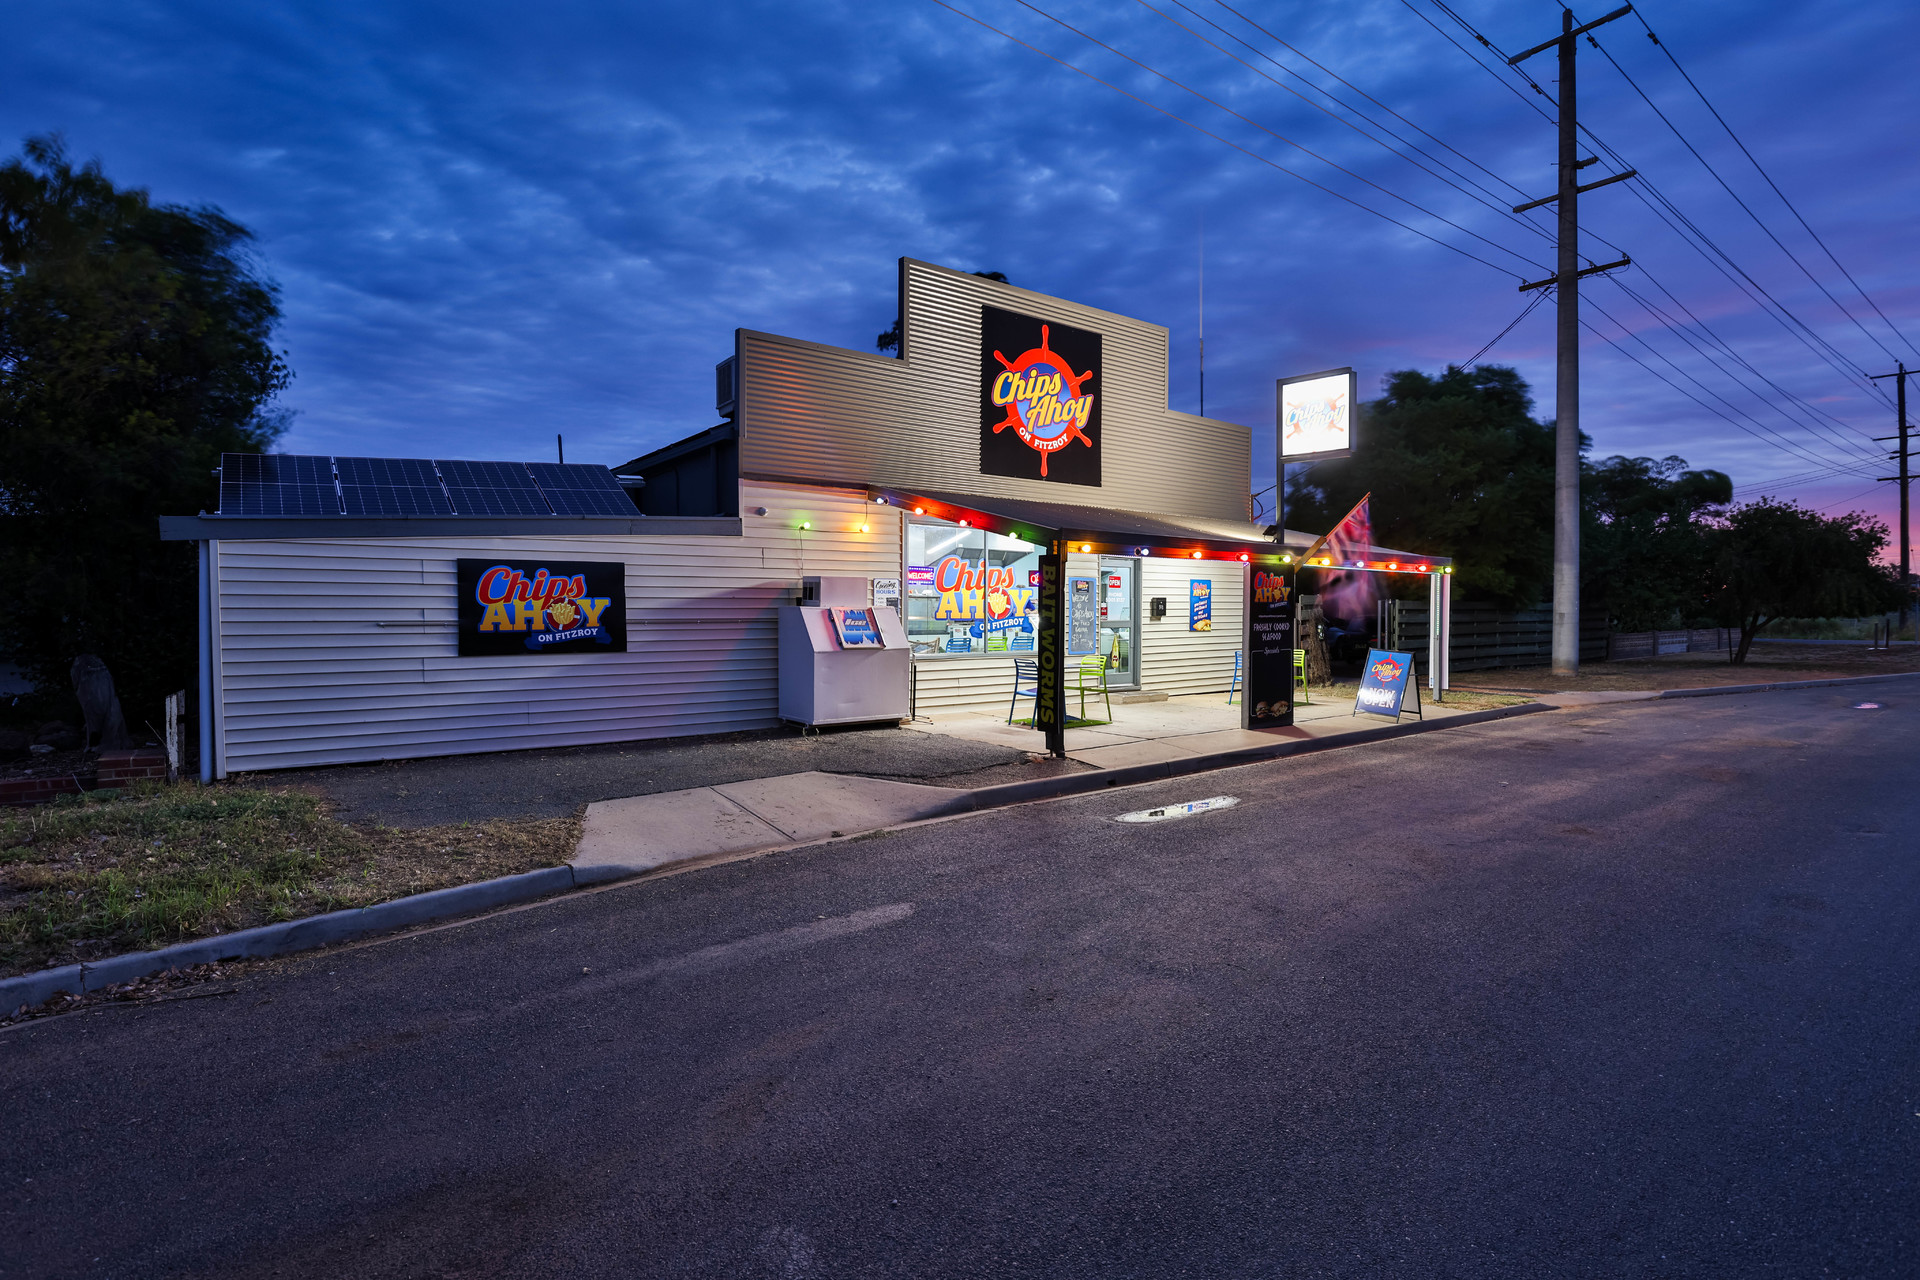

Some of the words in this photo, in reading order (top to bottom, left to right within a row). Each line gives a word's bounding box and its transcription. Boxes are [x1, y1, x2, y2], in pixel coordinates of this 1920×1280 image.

[993, 369, 1062, 408] Chips
[1027, 395, 1093, 433] Ahoy
[1019, 427, 1031, 442] ON
[1034, 433, 1068, 450] FITZROY
[907, 572, 932, 580] WELCOME
[936, 557, 1014, 599] Chips
[1254, 572, 1284, 590] Chips
[478, 567, 585, 610] Chips
[1042, 565, 1056, 622] BAIT
[1254, 587, 1290, 603] AHOY
[936, 588, 1032, 619] AHOY
[480, 597, 609, 632] AHOY
[992, 618, 1024, 630] FITZROY
[1254, 623, 1272, 631] FRESHLY
[1273, 622, 1290, 630] COOKED
[538, 633, 553, 643] ON
[555, 628, 598, 642] FITZROY
[1262, 632, 1281, 640] SEAFOOD
[1040, 629, 1055, 724] WORMS
[1371, 663, 1394, 673] Chips
[1370, 688, 1396, 700] NOW
[1364, 698, 1395, 709] OPEN
